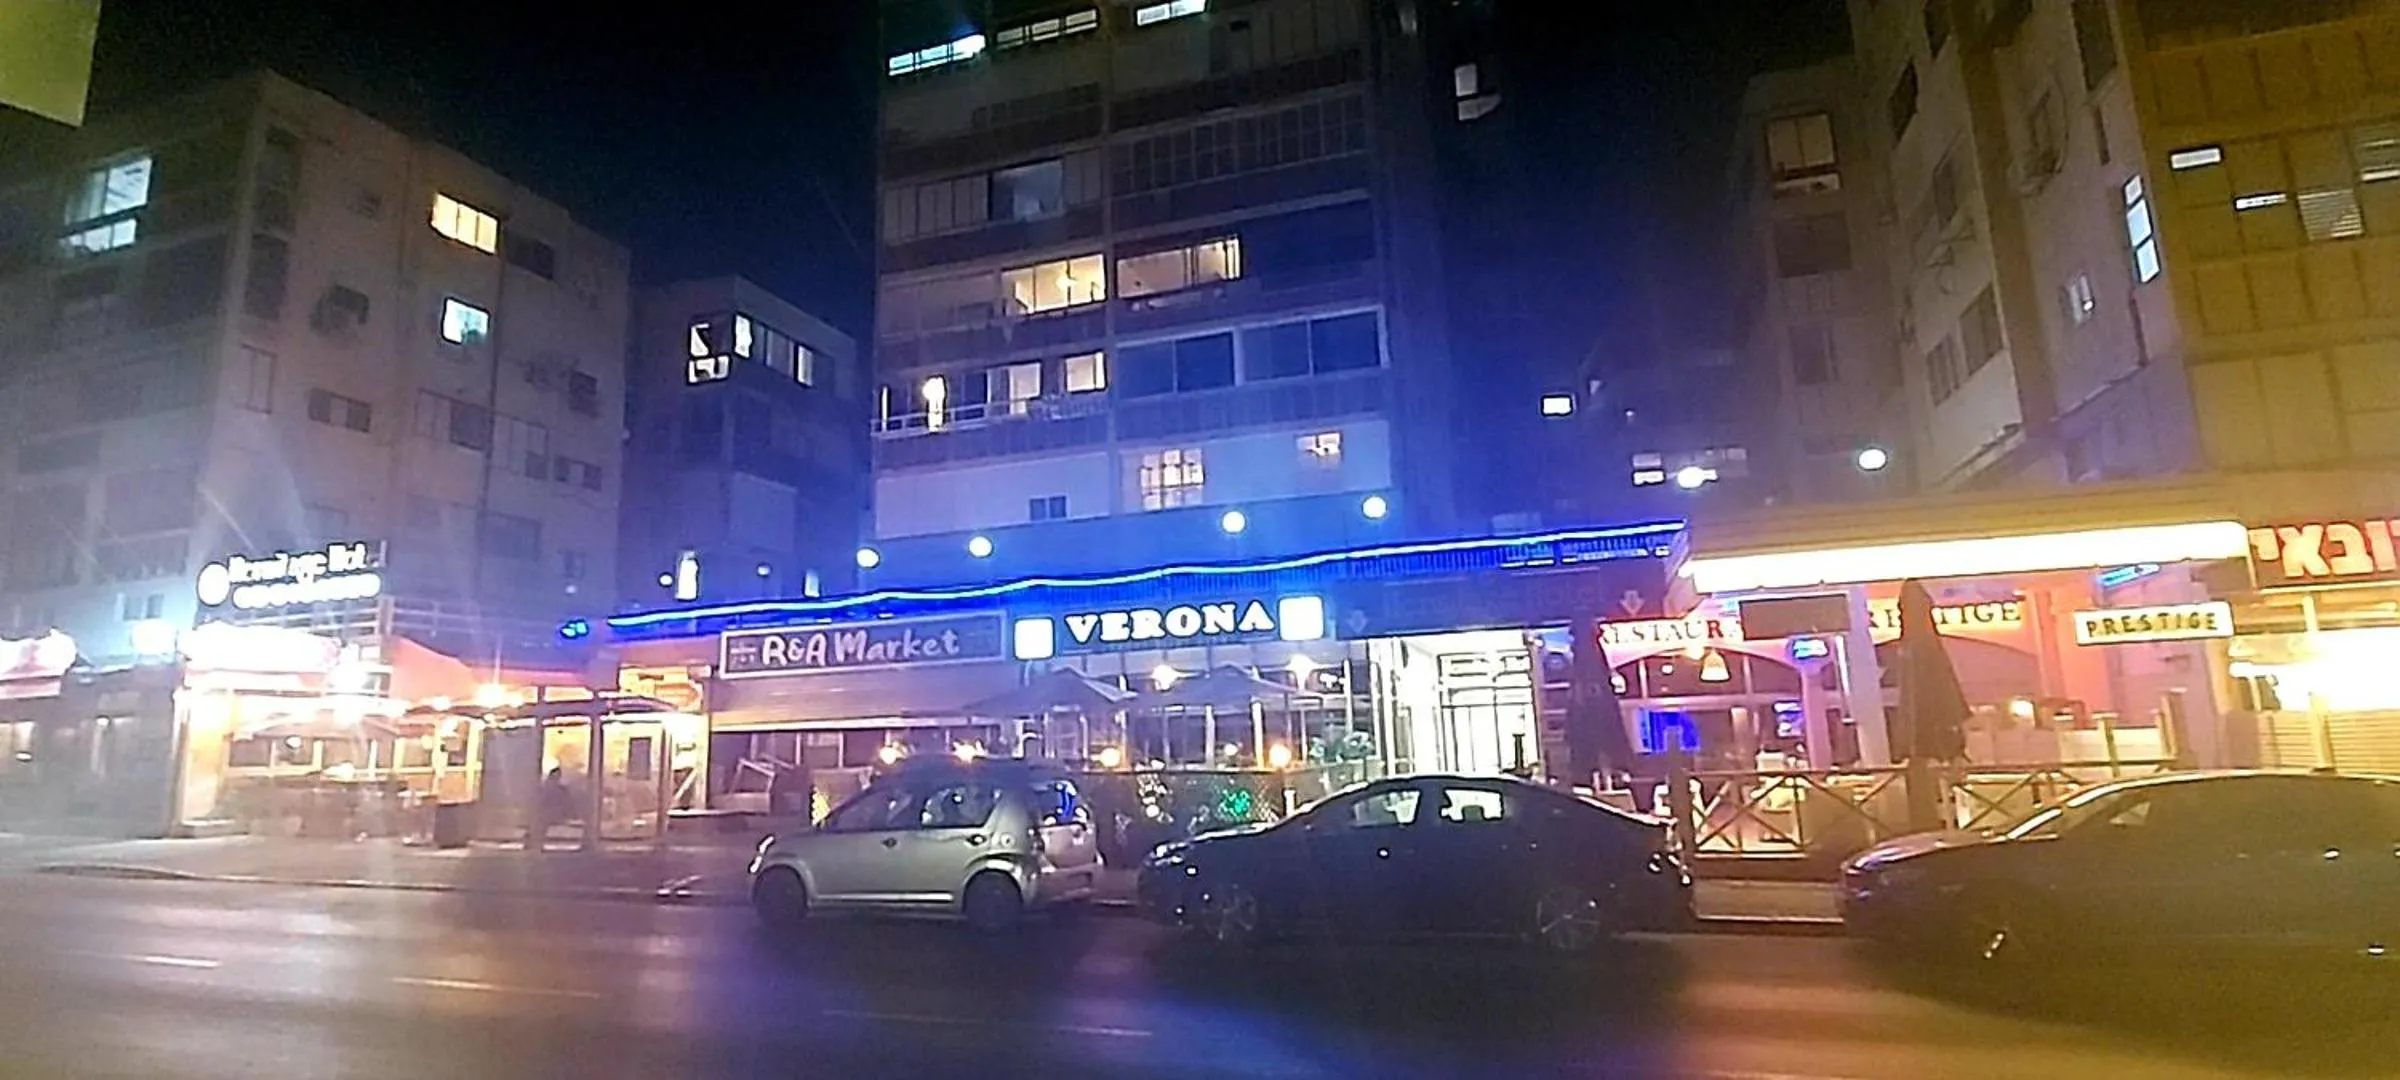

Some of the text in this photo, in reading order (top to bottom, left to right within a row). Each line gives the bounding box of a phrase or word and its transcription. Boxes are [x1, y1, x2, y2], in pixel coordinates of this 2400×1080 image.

[2248, 519, 2400, 578] ובאי
[1065, 600, 1275, 644] VERONA
[2086, 612, 2218, 638] PRESTIGE
[762, 627, 960, 667] R&A Market
